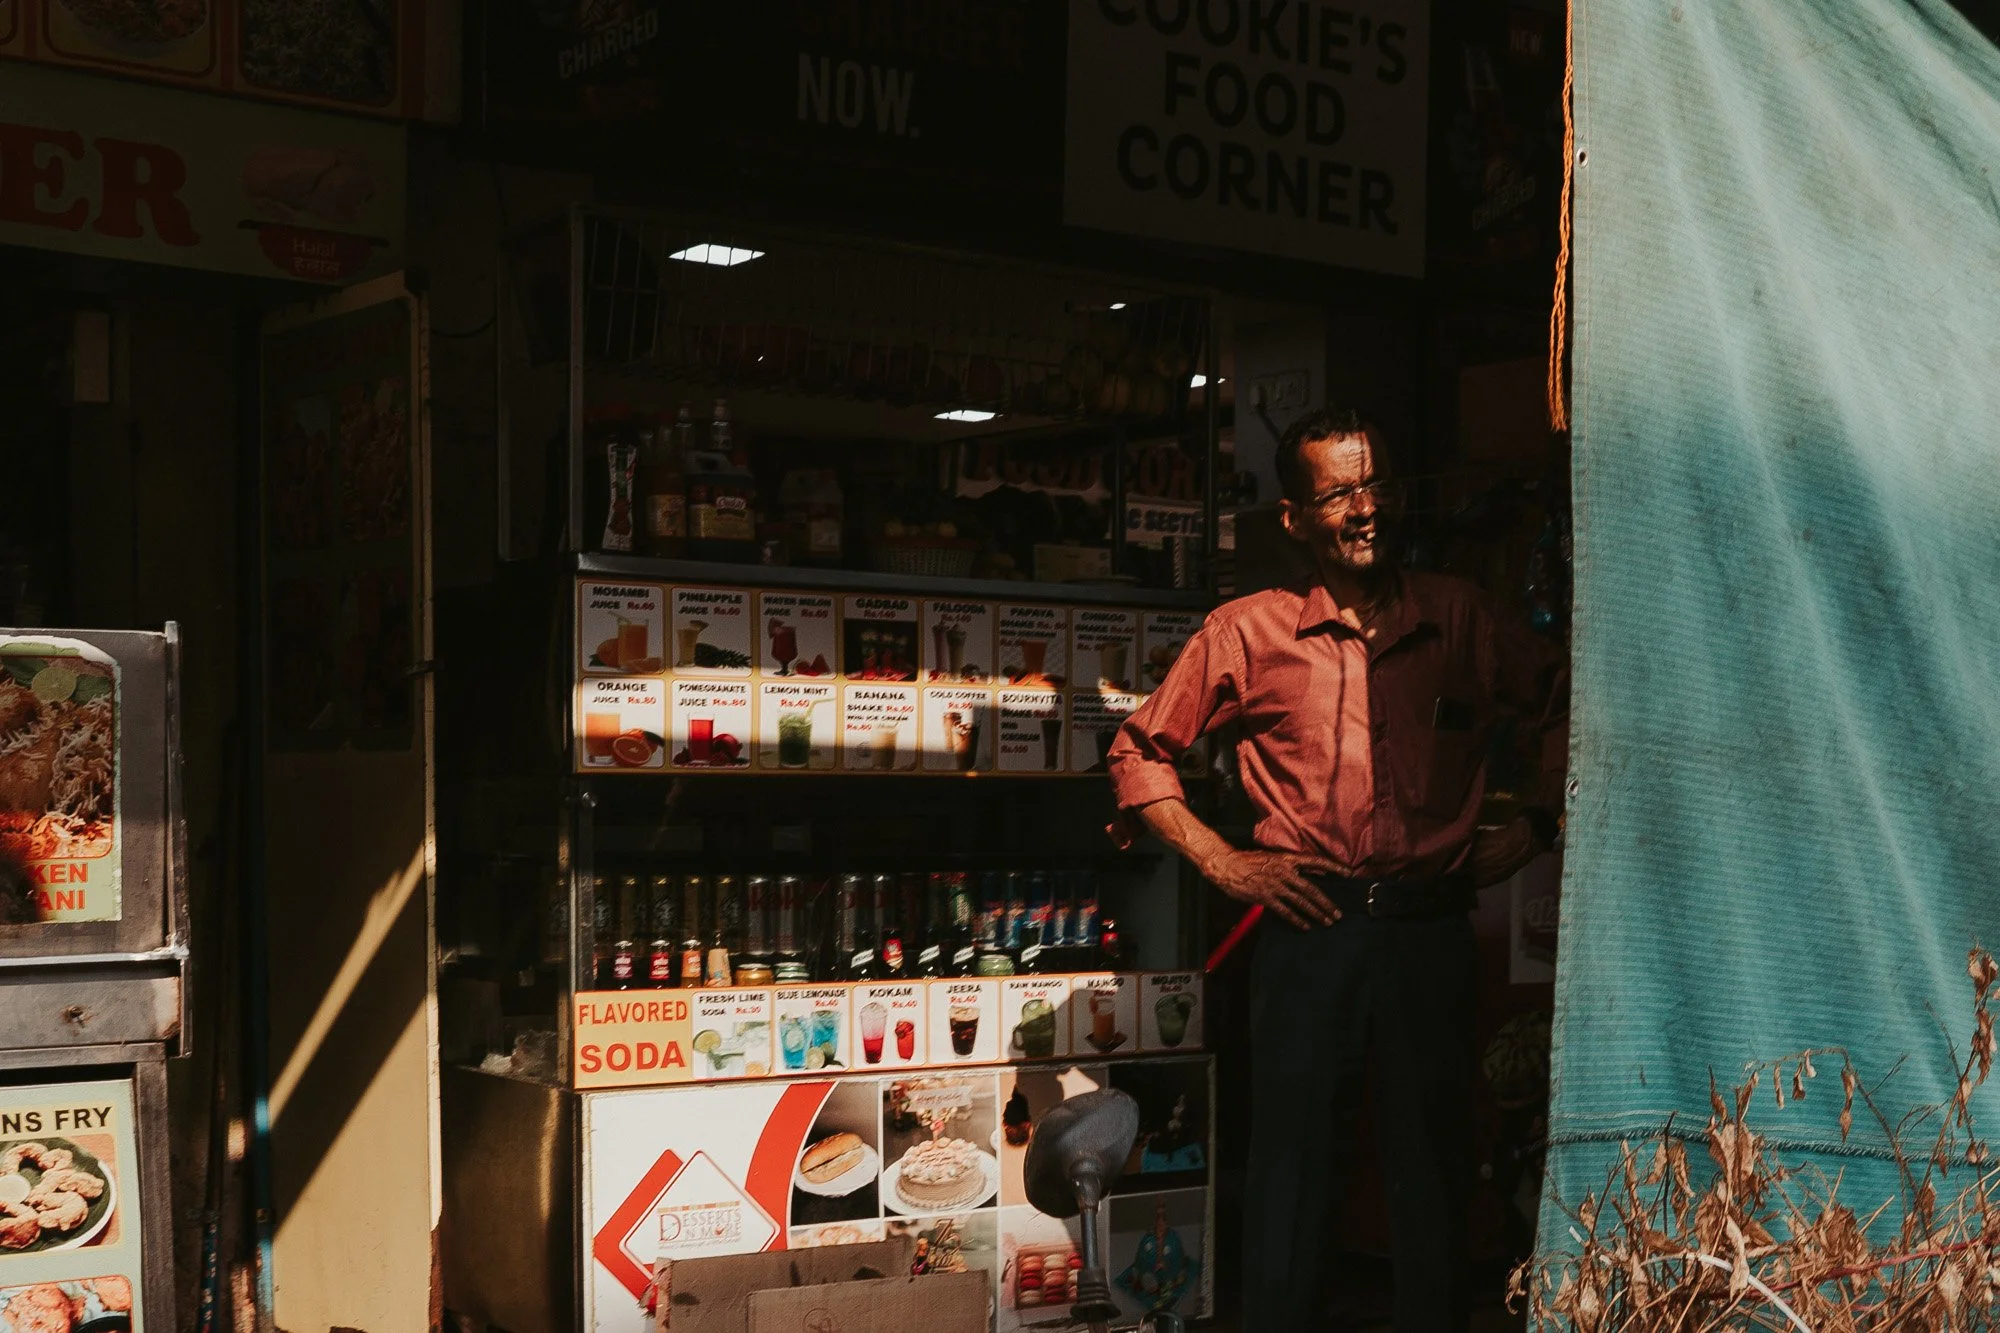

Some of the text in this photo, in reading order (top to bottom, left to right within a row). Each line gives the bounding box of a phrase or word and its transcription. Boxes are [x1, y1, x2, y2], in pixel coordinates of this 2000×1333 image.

[557, 8, 659, 80] CHARGED
[797, 51, 921, 139] NOW.
[1165, 50, 1346, 146] FOOD
[1117, 124, 1398, 236] CORNER
[293, 238, 337, 257] Halal
[592, 586, 650, 600] MOSAMBI
[678, 592, 743, 605] PINEAPPLE
[590, 600, 621, 611] JUICE
[764, 596, 832, 608] WATER MELON
[855, 598, 909, 611] GADBAD
[679, 606, 709, 617] JUICE
[764, 608, 791, 617] JUICE
[933, 602, 987, 615] FALOODA
[1010, 608, 1055, 618] PAPAYA
[597, 681, 648, 692] ORANGE
[679, 683, 746, 694] POMEGRANATE
[764, 686, 829, 696] LEMON MINT
[592, 696, 620, 705] JUICE
[854, 691, 906, 700] BANANA
[930, 690, 987, 701] COLD COFFEE
[1002, 693, 1063, 706] BOURNVITA
[679, 698, 708, 708] JUICE
[847, 703, 883, 712] SHAKE
[1001, 708, 1031, 719] SHAKE
[1008, 979, 1063, 991] RAW MANGO
[1086, 976, 1125, 989] MANGO
[1151, 974, 1192, 986] MOJITO
[777, 988, 847, 1001] BLUE LEMONADE
[869, 987, 913, 1000] KOKAM
[946, 984, 982, 995] JEERA
[699, 993, 766, 1004] FRESH LIME
[578, 1001, 687, 1025] FLAVORED
[701, 1008, 727, 1017] SODA
[580, 1041, 686, 1074] SODA
[2, 1106, 114, 1135] NS FRY
[660, 1208, 742, 1242] DESSERTS
